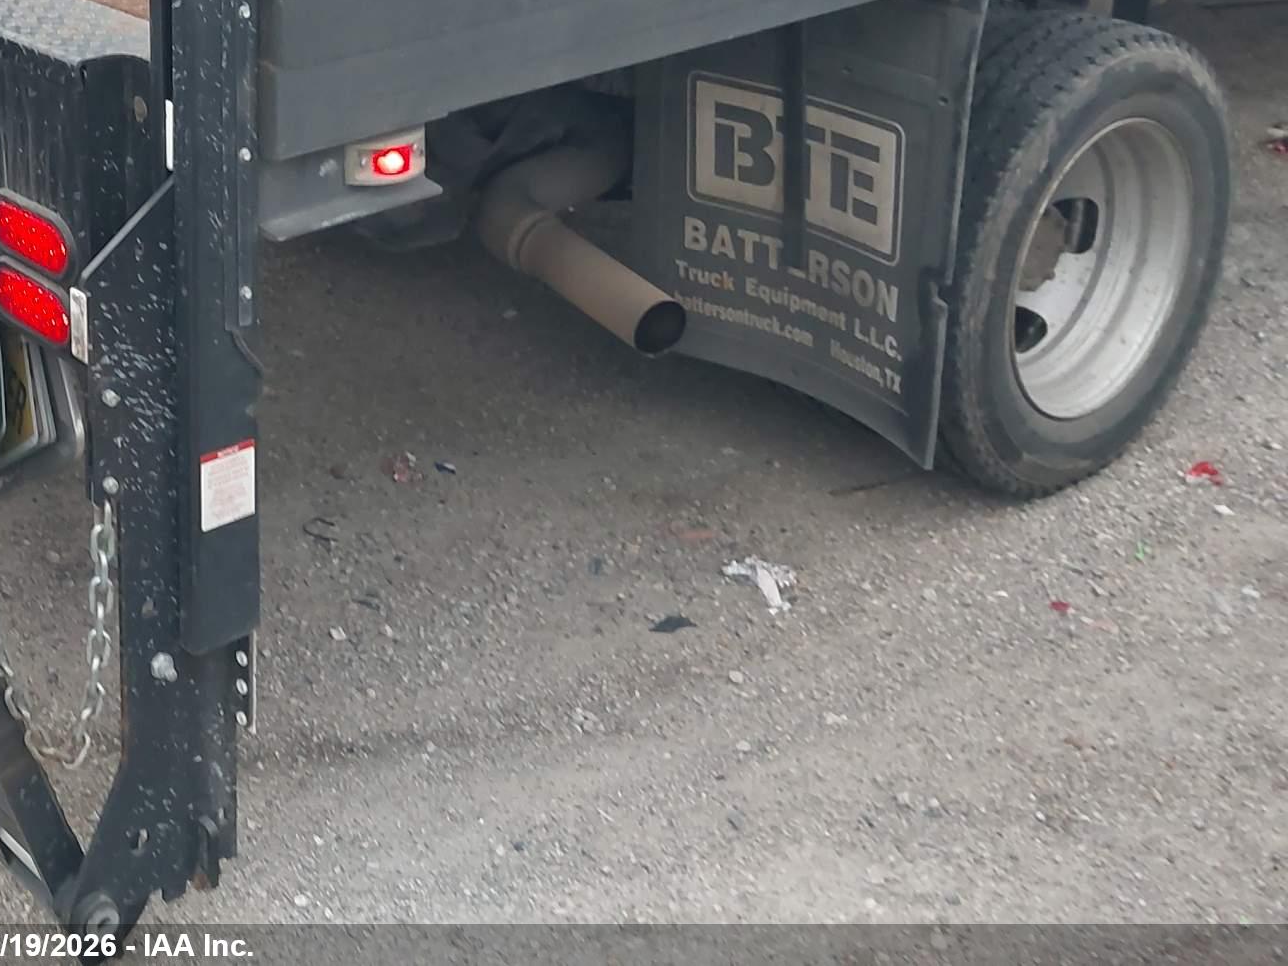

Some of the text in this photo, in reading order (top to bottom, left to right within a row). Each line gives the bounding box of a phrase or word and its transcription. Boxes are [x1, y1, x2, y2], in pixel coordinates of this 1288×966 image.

[675, 259, 902, 361] Truck Equipment L.L.C.
[683, 215, 899, 323] BATTRSON
